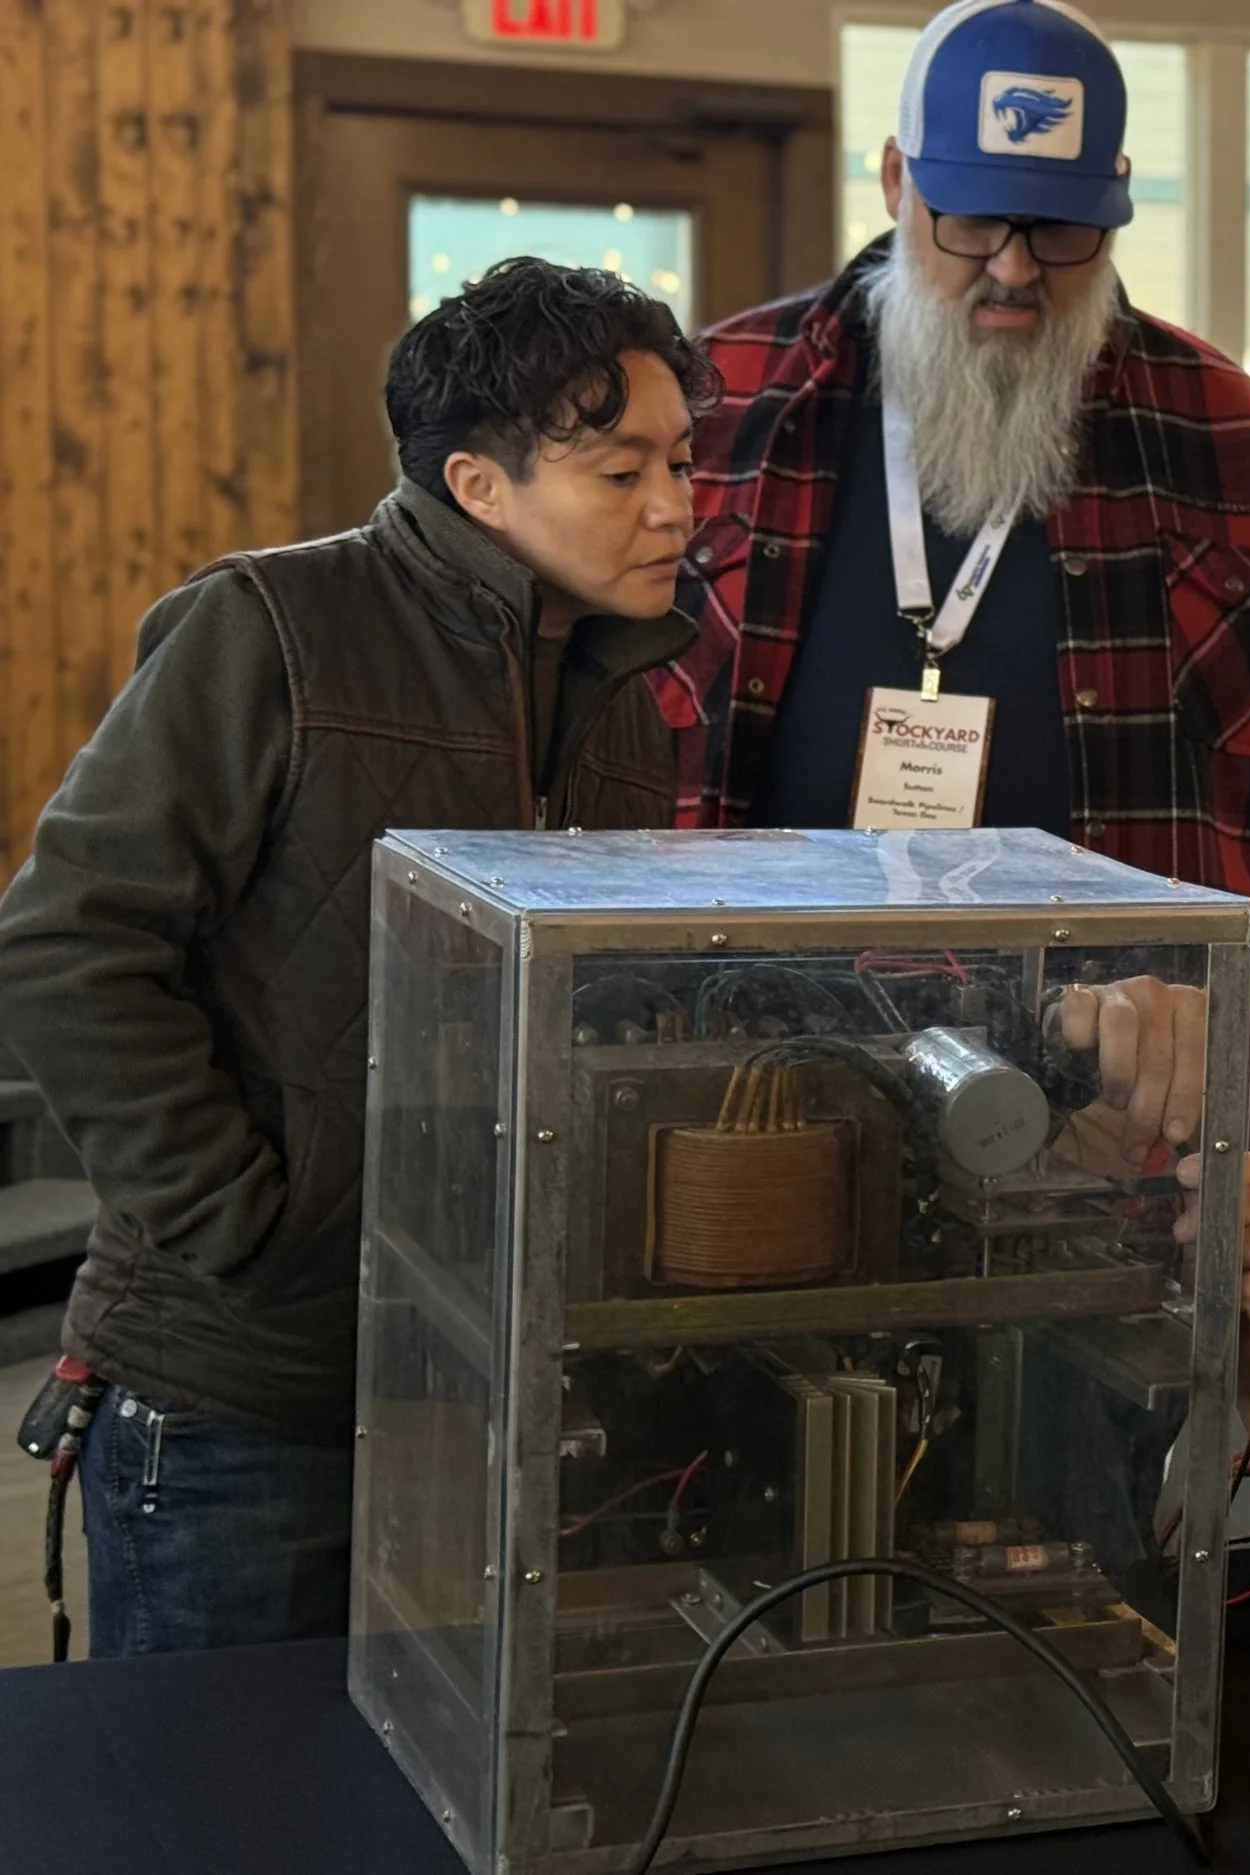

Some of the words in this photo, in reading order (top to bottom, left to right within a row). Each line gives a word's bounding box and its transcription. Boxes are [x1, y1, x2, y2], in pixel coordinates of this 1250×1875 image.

[872, 720, 980, 743] STOCKYARD
[882, 736, 917, 749] SHORT
[928, 741, 968, 754] COURSE
[899, 761, 943, 775] Morris
